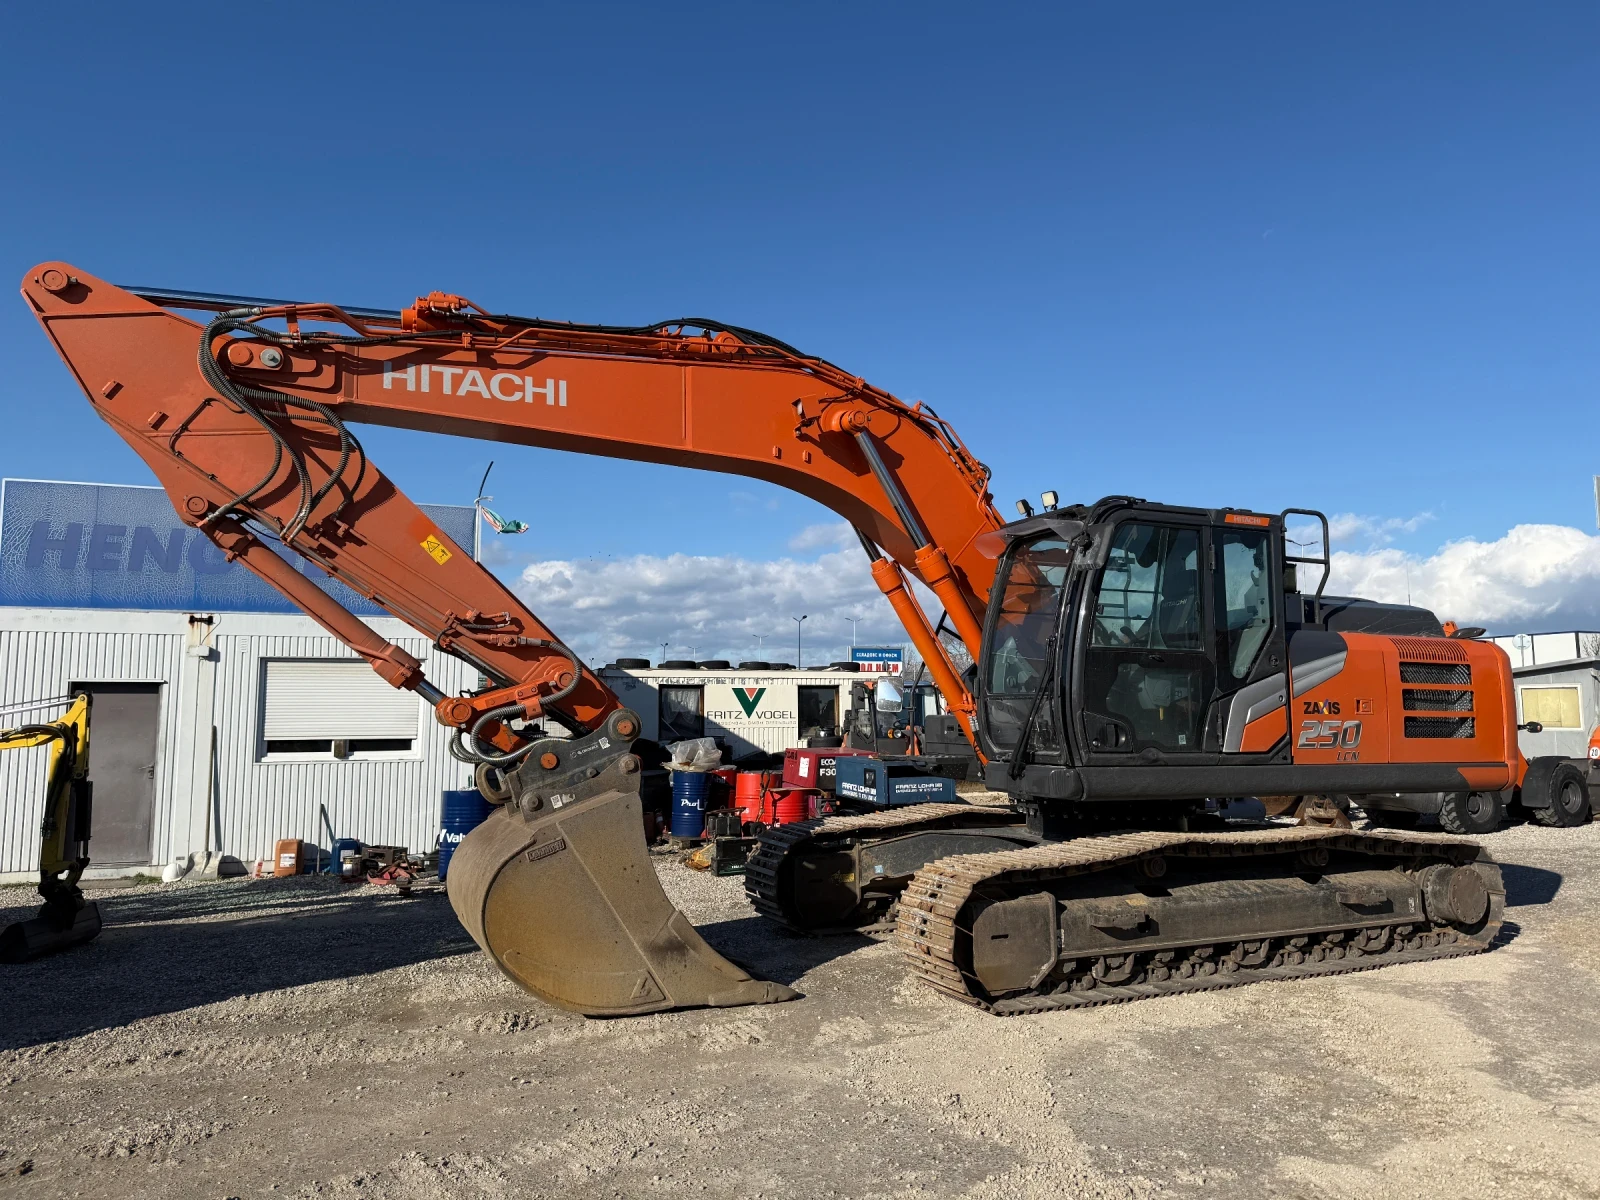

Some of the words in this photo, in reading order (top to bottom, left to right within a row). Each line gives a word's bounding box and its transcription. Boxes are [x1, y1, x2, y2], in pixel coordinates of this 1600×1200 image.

[383, 361, 568, 408] HITACHI
[1233, 515, 1261, 525] HITACHI
[1303, 699, 1341, 715] ZAXIS
[706, 710, 743, 720] FRITZ
[755, 710, 796, 720] VOGEL
[1297, 720, 1363, 749] 250
[1336, 751, 1360, 762] LCN
[1591, 748, 1599, 757] 20
